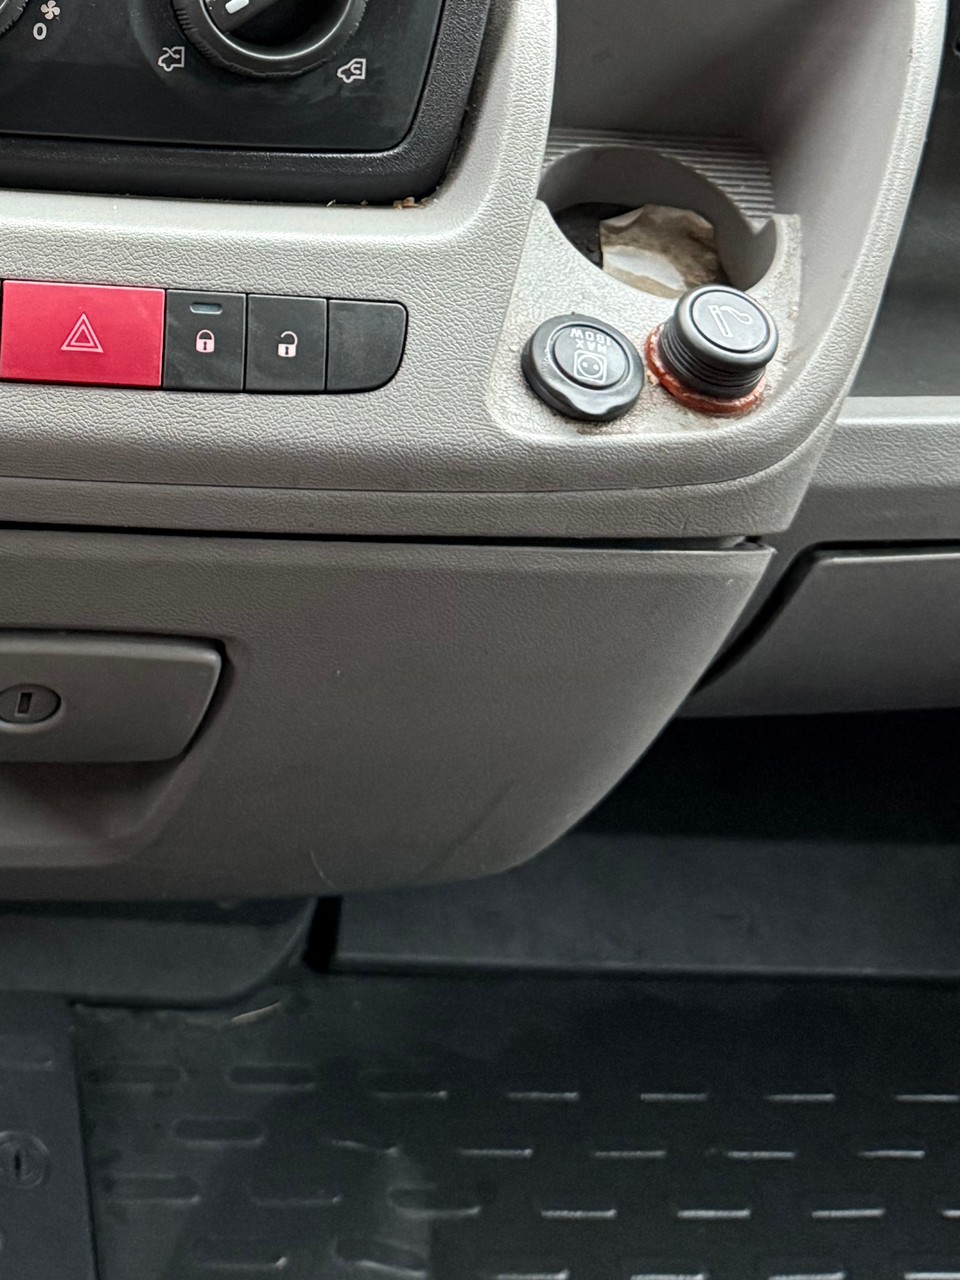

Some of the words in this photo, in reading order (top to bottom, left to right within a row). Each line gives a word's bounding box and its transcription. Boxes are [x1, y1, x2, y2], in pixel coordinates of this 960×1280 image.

[32, 22, 47, 40] 0
[569, 328, 611, 346] 180W
[575, 339, 607, 353] MAX
